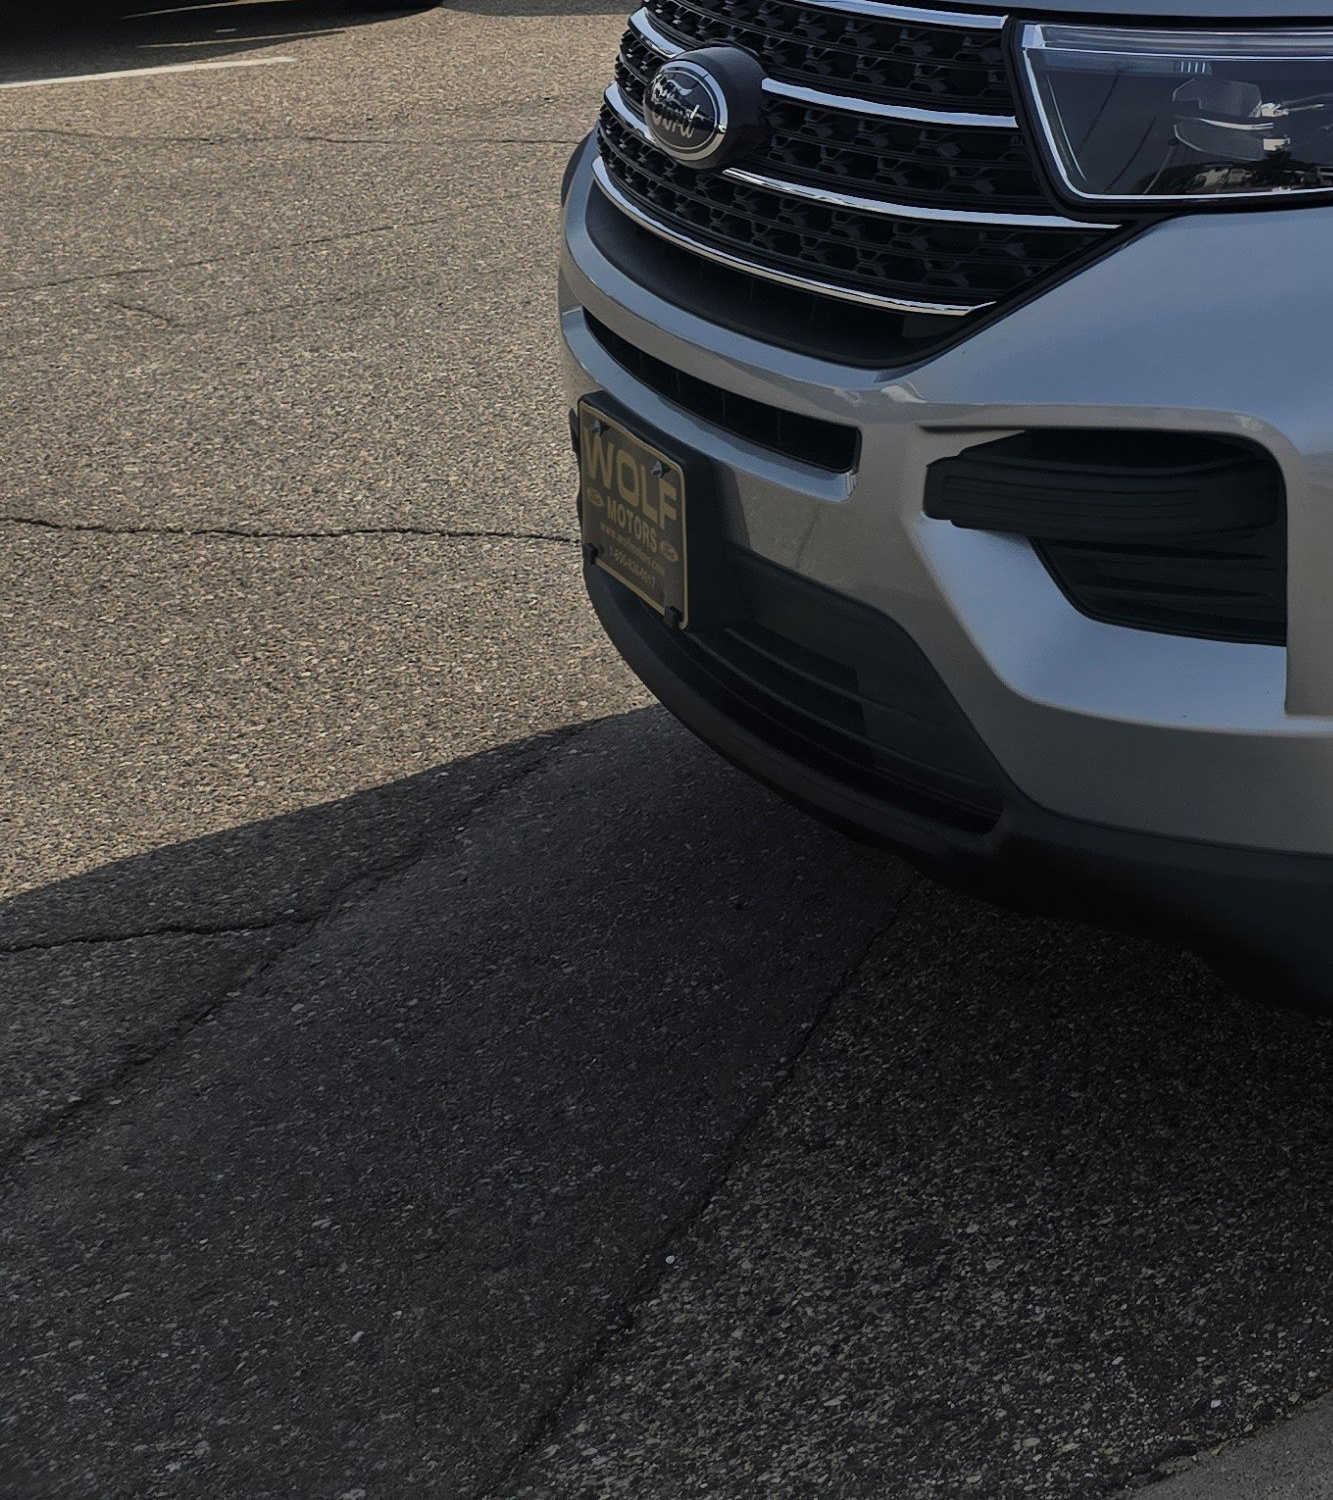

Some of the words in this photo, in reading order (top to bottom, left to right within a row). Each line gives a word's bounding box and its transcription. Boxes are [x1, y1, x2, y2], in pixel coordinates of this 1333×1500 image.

[652, 77, 699, 138] Ford
[584, 426, 677, 531] WOLF
[607, 496, 657, 554] MOTORS
